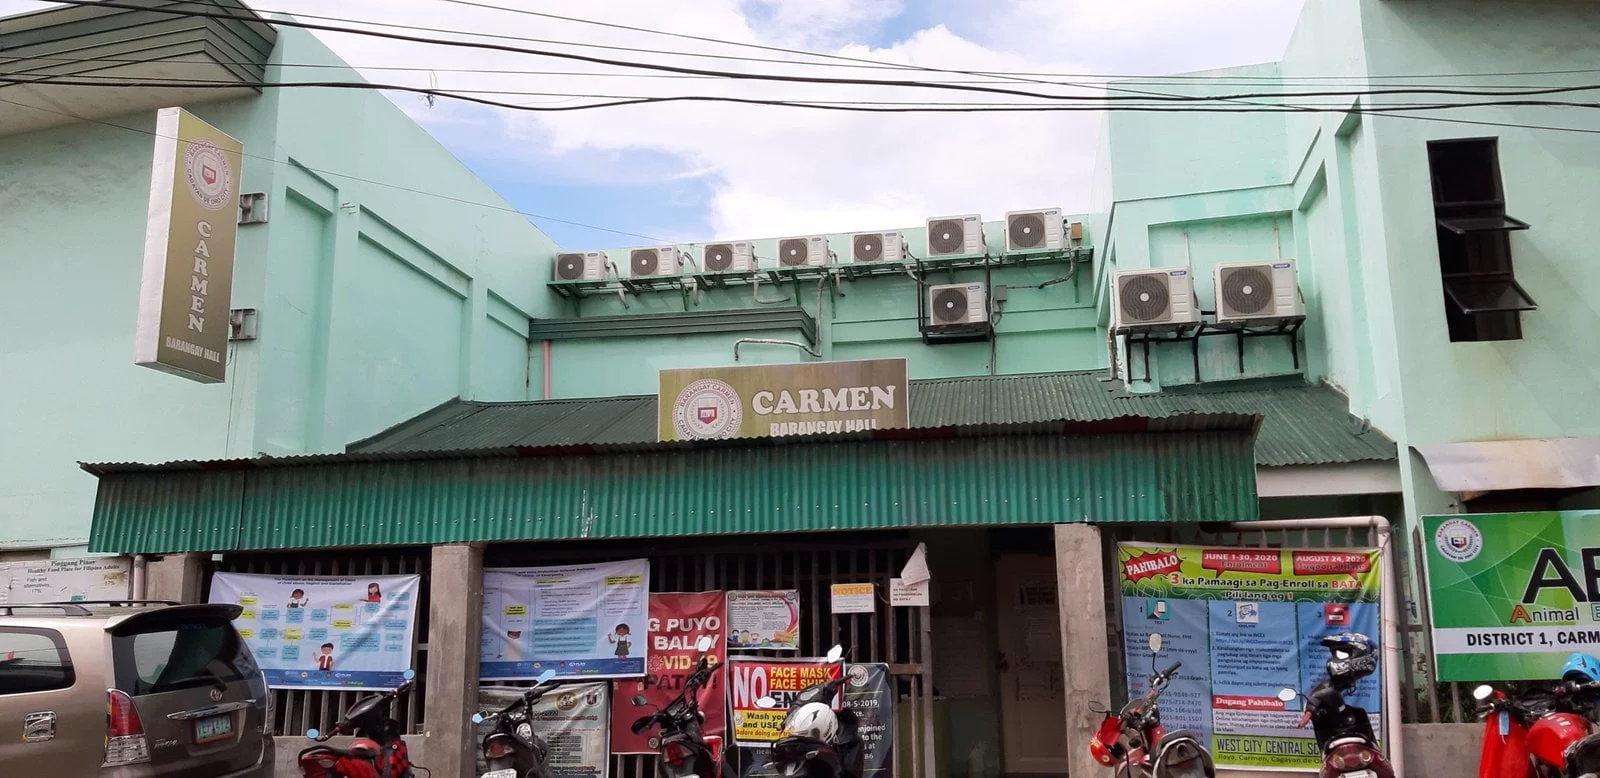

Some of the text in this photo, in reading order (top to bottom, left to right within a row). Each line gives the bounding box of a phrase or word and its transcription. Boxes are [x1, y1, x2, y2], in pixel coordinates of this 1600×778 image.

[203, 196, 210, 204] DE
[210, 197, 222, 205] ORO
[188, 221, 212, 334] CARMEN
[166, 336, 221, 364] BARANGAY HALL
[680, 384, 736, 408] BARANGAY CARMEN
[752, 385, 898, 416] CARMEN
[726, 418, 737, 432] CITY
[770, 419, 878, 438] BARANGAY HALL
[1126, 554, 1180, 576] PAHIBALO
[1232, 554, 1253, 562] 1-30,
[1254, 554, 1278, 562] 2020
[1330, 556, 1344, 564] 24,
[1170, 574, 1364, 590] 3 ka Pamaagi sa Pag-Enroll sa BATA
[832, 586, 873, 596] NOTICE
[1226, 591, 1242, 599] Pili
[1244, 592, 1268, 600] lang
[1510, 604, 1580, 624] Animal
[648, 618, 660, 632] G
[666, 616, 720, 632] PUYO
[1467, 632, 1600, 647] DISTRICT 1, CARM
[663, 655, 718, 670] VID-9
[734, 666, 832, 709] NO FACE MASK
[770, 679, 826, 690] FACE SHIE
[1216, 698, 1284, 707] Dugang Pahibalo
[747, 712, 789, 722] Wash you
[755, 730, 771, 738] doing
[858, 724, 886, 734] njoined
[871, 732, 883, 740] the
[868, 742, 876, 750] at
[1217, 738, 1320, 756] WEST CITY CENTRAL SC
